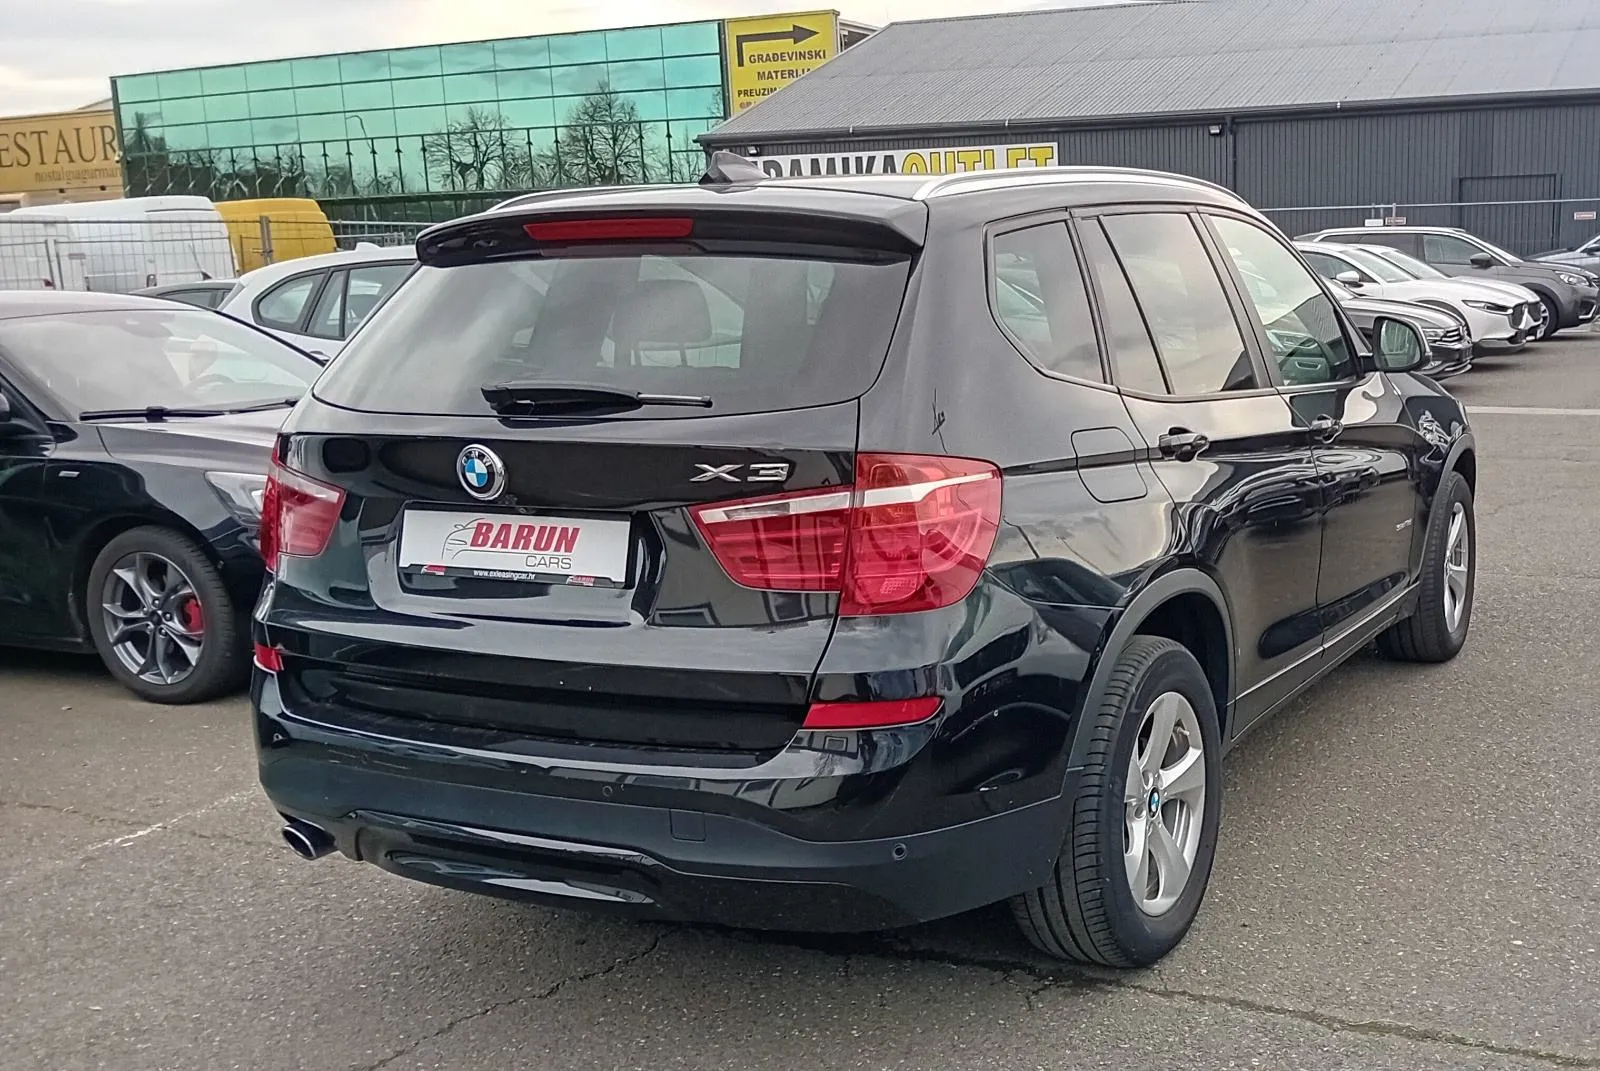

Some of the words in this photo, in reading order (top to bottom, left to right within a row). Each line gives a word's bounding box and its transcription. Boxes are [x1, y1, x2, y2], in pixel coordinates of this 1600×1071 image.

[748, 49, 826, 64] GRAĐEVINSKI
[689, 463, 790, 482] X3
[470, 521, 581, 554] BARUN
[525, 555, 572, 570] CARS
